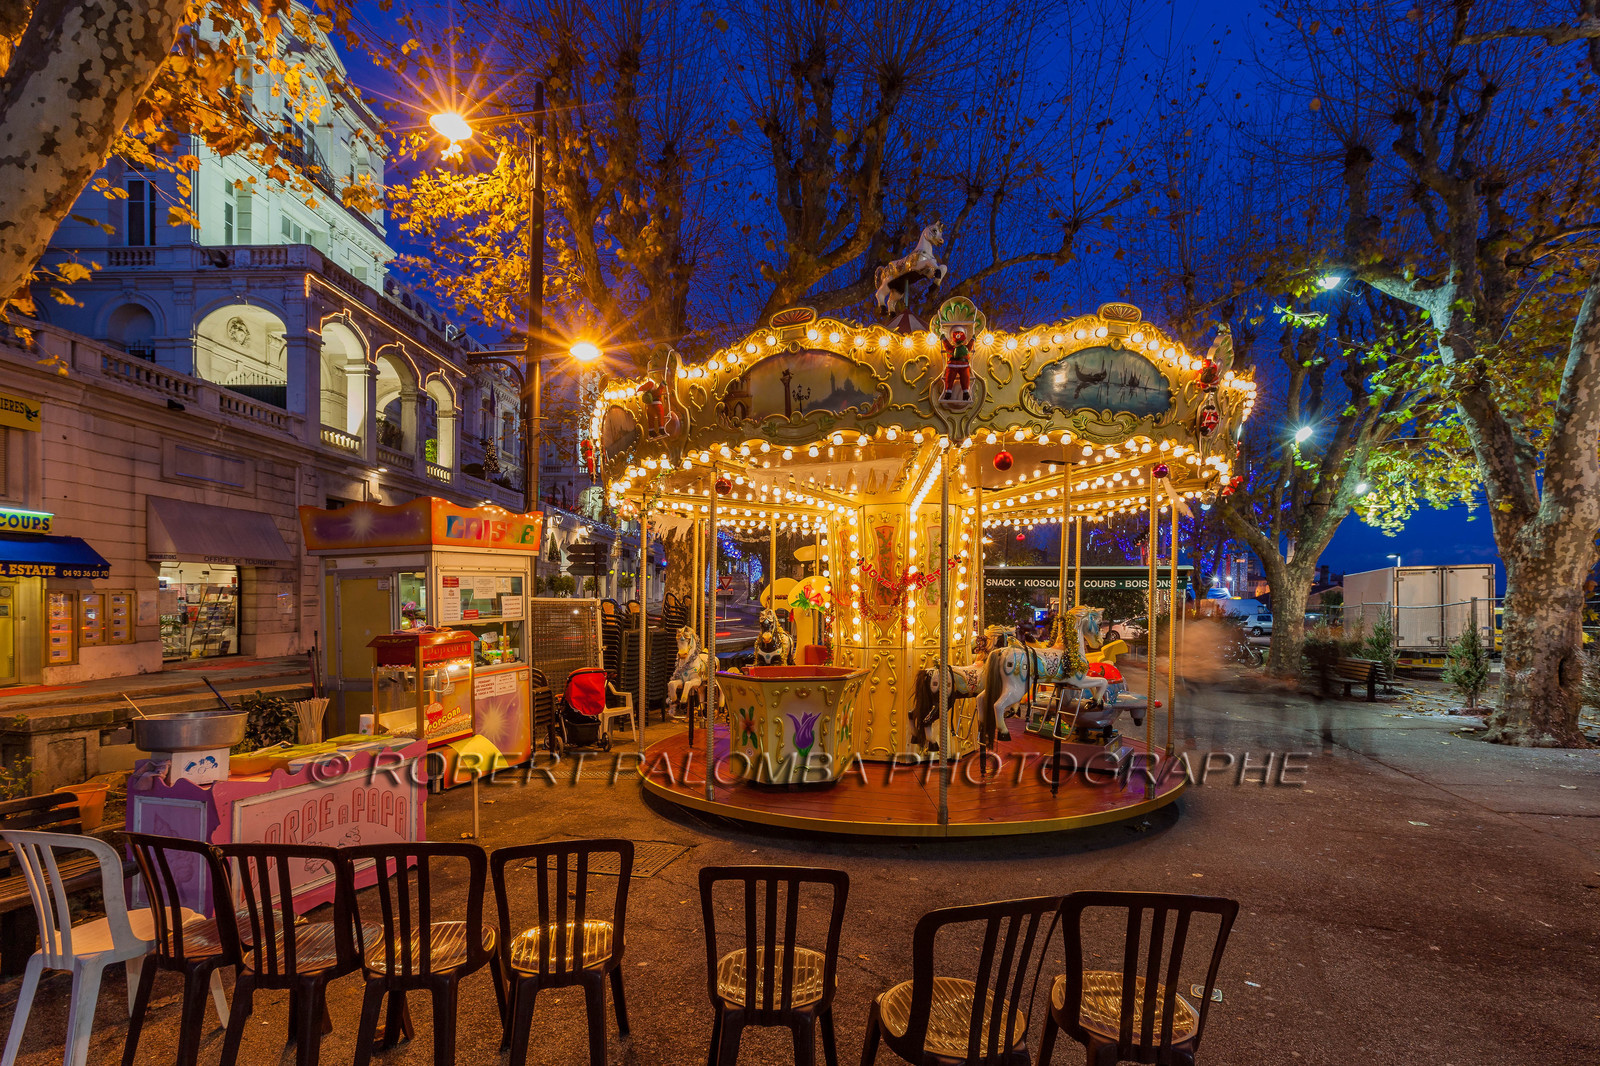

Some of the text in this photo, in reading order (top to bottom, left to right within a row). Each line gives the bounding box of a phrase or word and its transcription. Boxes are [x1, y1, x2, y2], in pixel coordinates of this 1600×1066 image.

[446, 515, 535, 544] CAISSE
[9, 564, 56, 576] ESTATE
[986, 578, 1016, 587] SNACK
[1024, 579, 1060, 588] KIOSQU
[1083, 580, 1117, 588] COURS
[428, 706, 461, 732] POPCORN
[352, 787, 407, 840] PAPA
